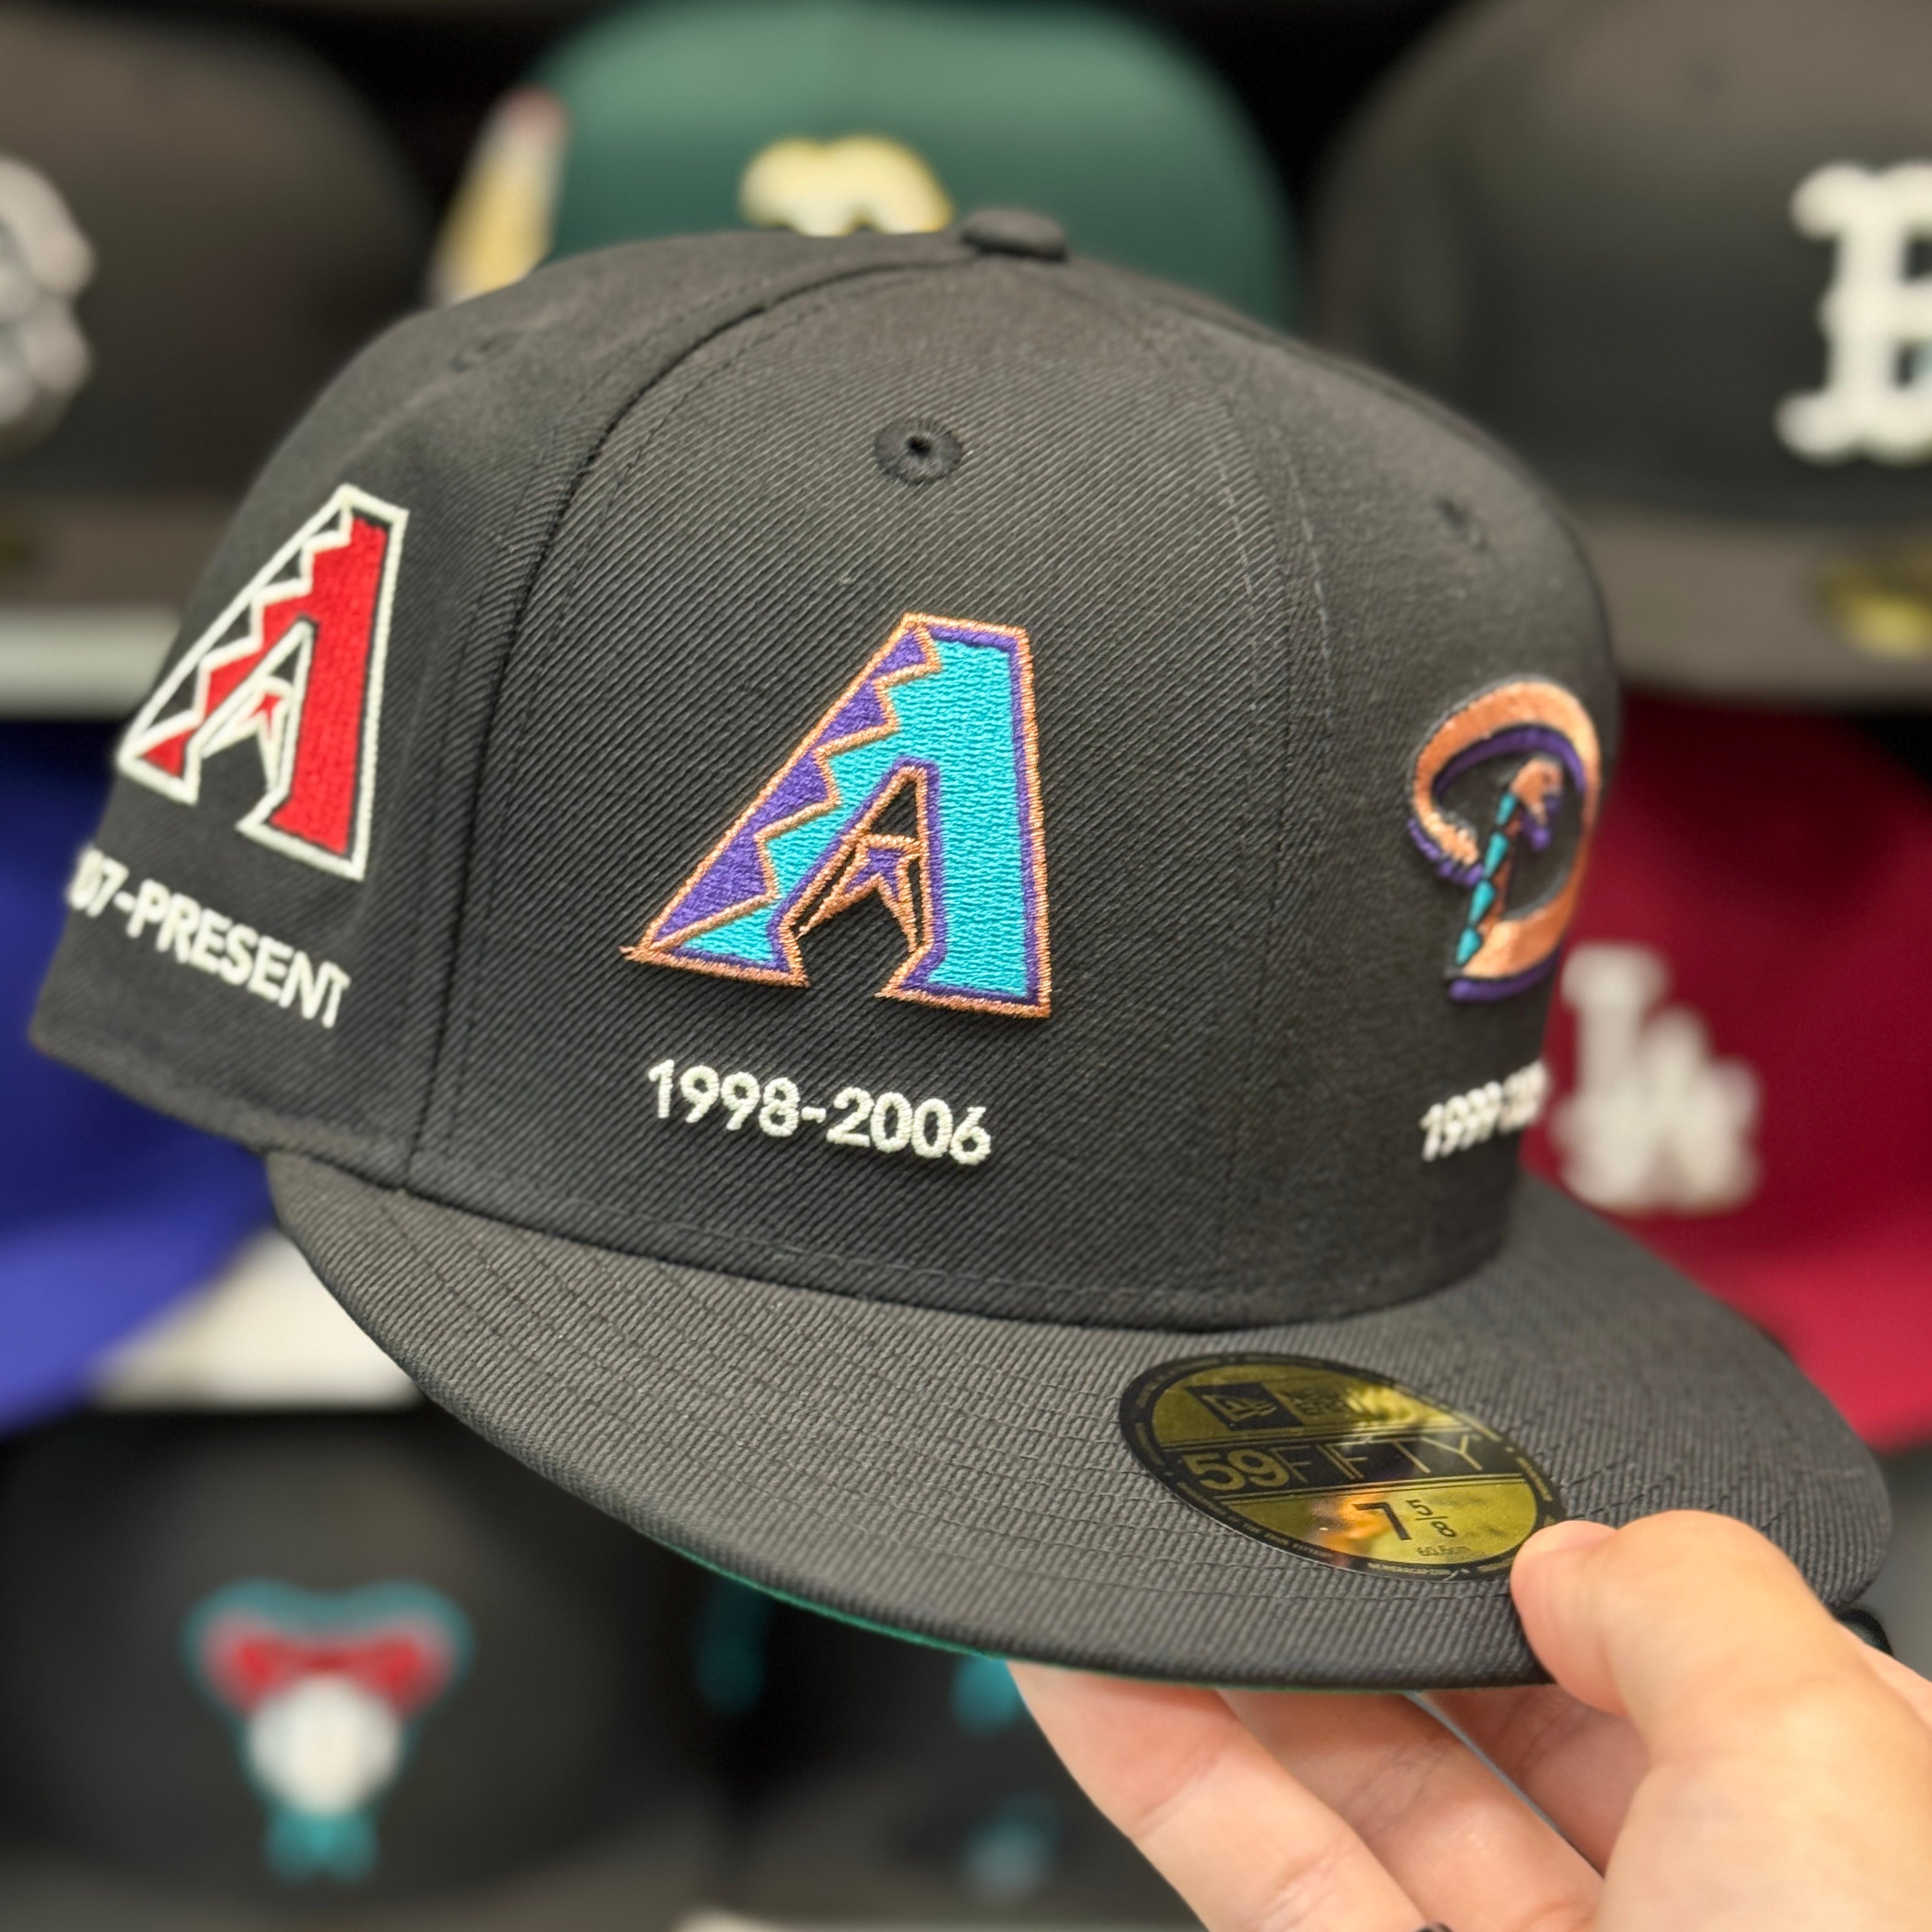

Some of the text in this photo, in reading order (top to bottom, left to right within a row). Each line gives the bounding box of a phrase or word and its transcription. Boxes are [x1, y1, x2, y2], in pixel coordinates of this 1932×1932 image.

[619, 612, 1052, 1018] A
[649, 1059, 991, 1165] 1998-2006
[1181, 1432, 1484, 1490] 59FIFTY
